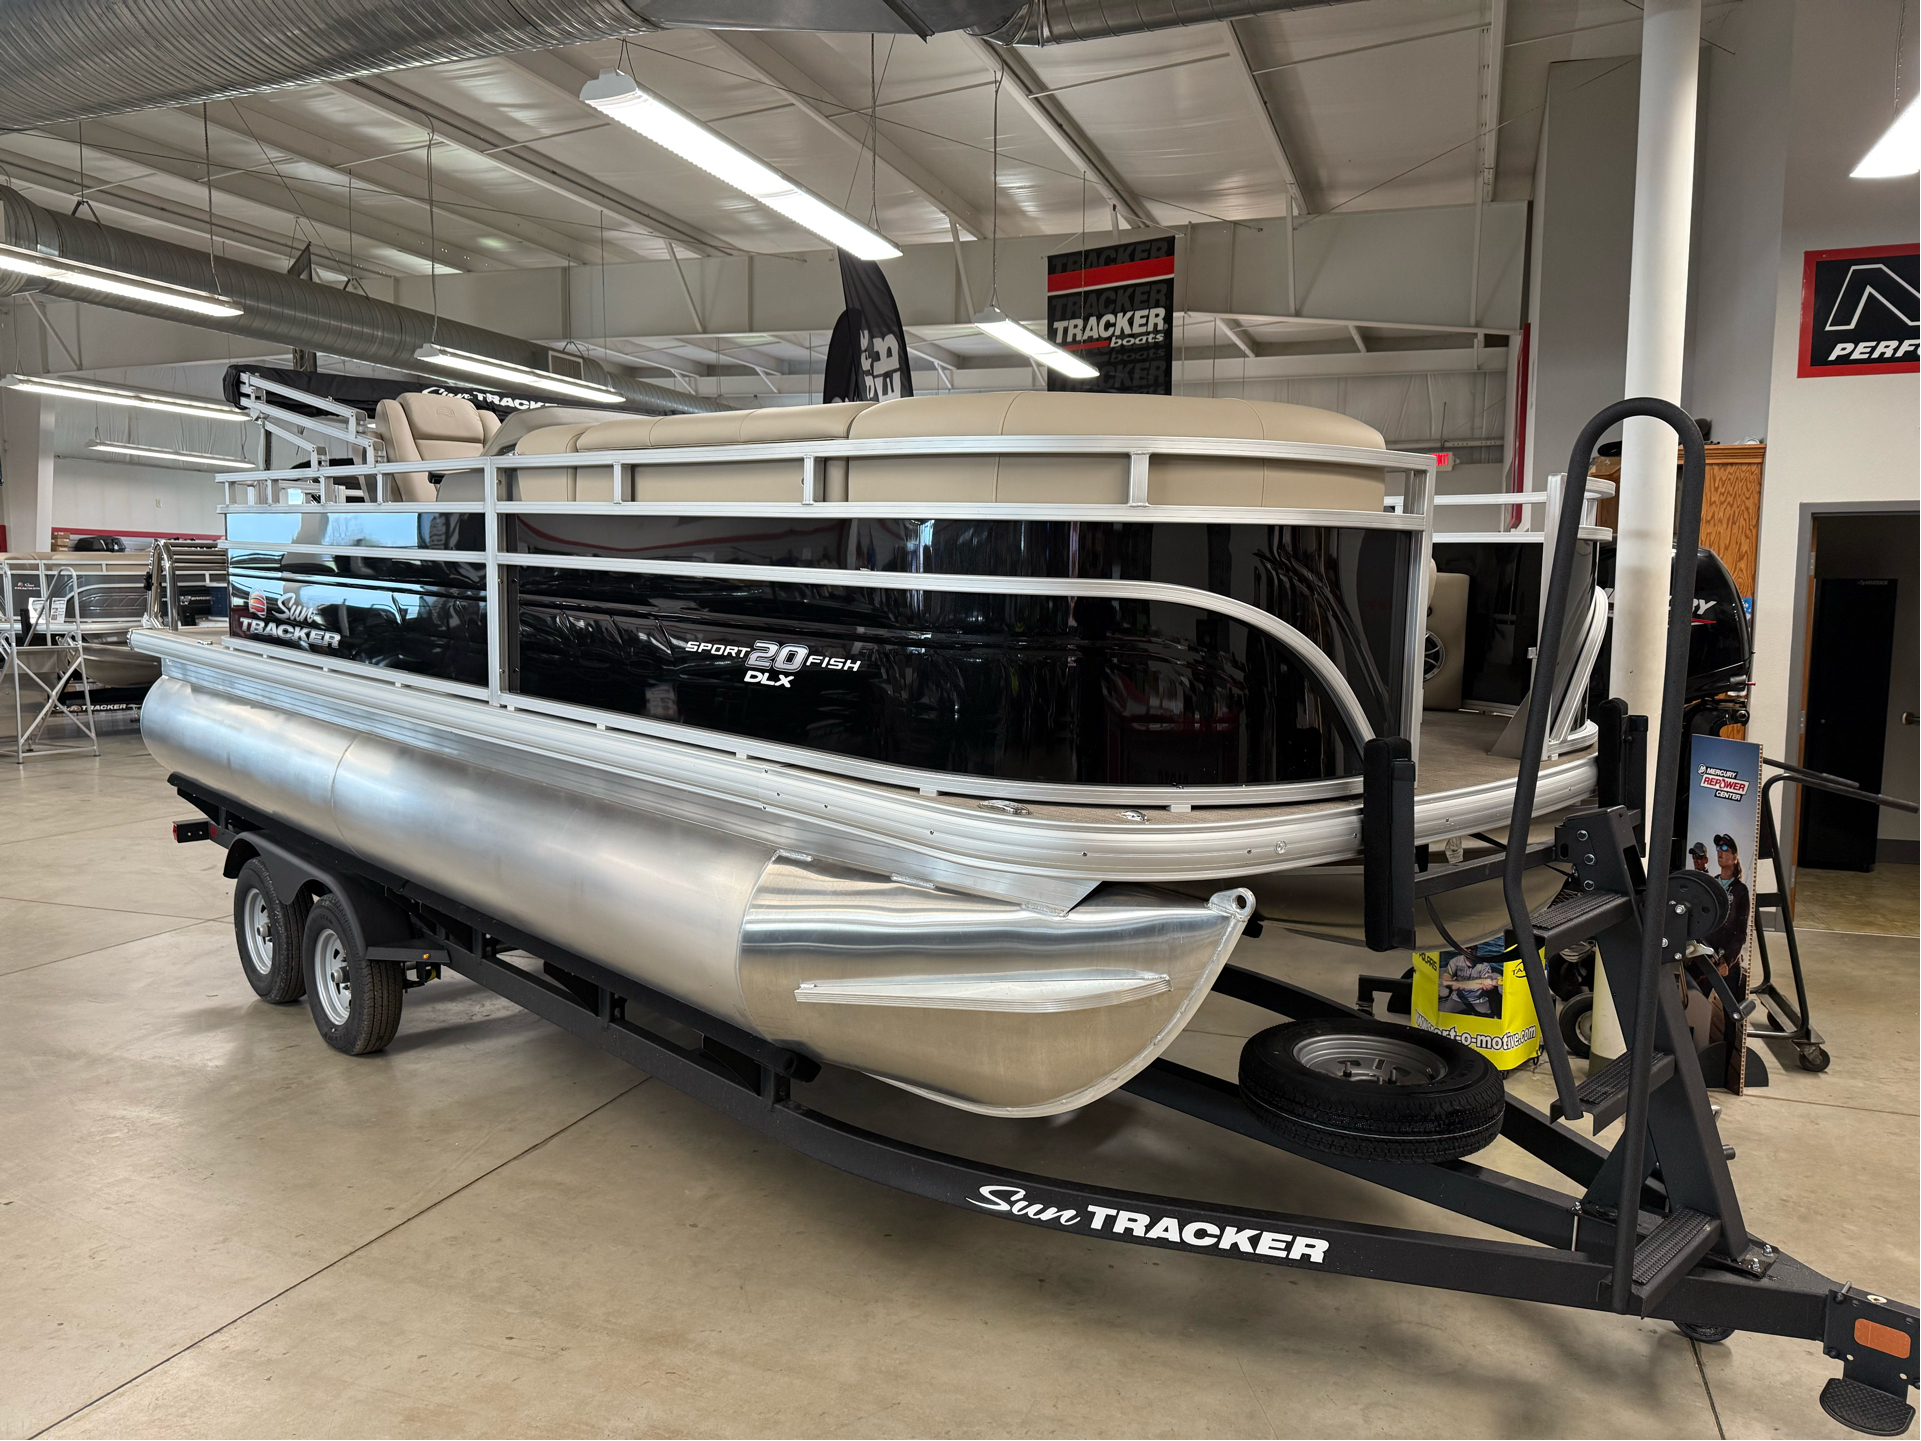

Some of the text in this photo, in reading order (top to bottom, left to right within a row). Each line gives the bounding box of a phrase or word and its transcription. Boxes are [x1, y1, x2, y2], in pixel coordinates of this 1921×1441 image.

[1053, 307, 1166, 344] TRACKER
[1110, 333, 1165, 348] boats
[1828, 339, 1920, 361] PERF
[473, 391, 560, 410] TRACK
[271, 592, 319, 623] Sun
[240, 617, 342, 649] TRACKER
[685, 640, 861, 672] SPORT 20 FISH
[744, 670, 794, 688] DLX
[1706, 767, 1738, 778] MERCURY
[1702, 776, 1747, 792] REPOWER
[1716, 790, 1741, 801] CENTER
[965, 1185, 1330, 1263] Sun TRACKER
